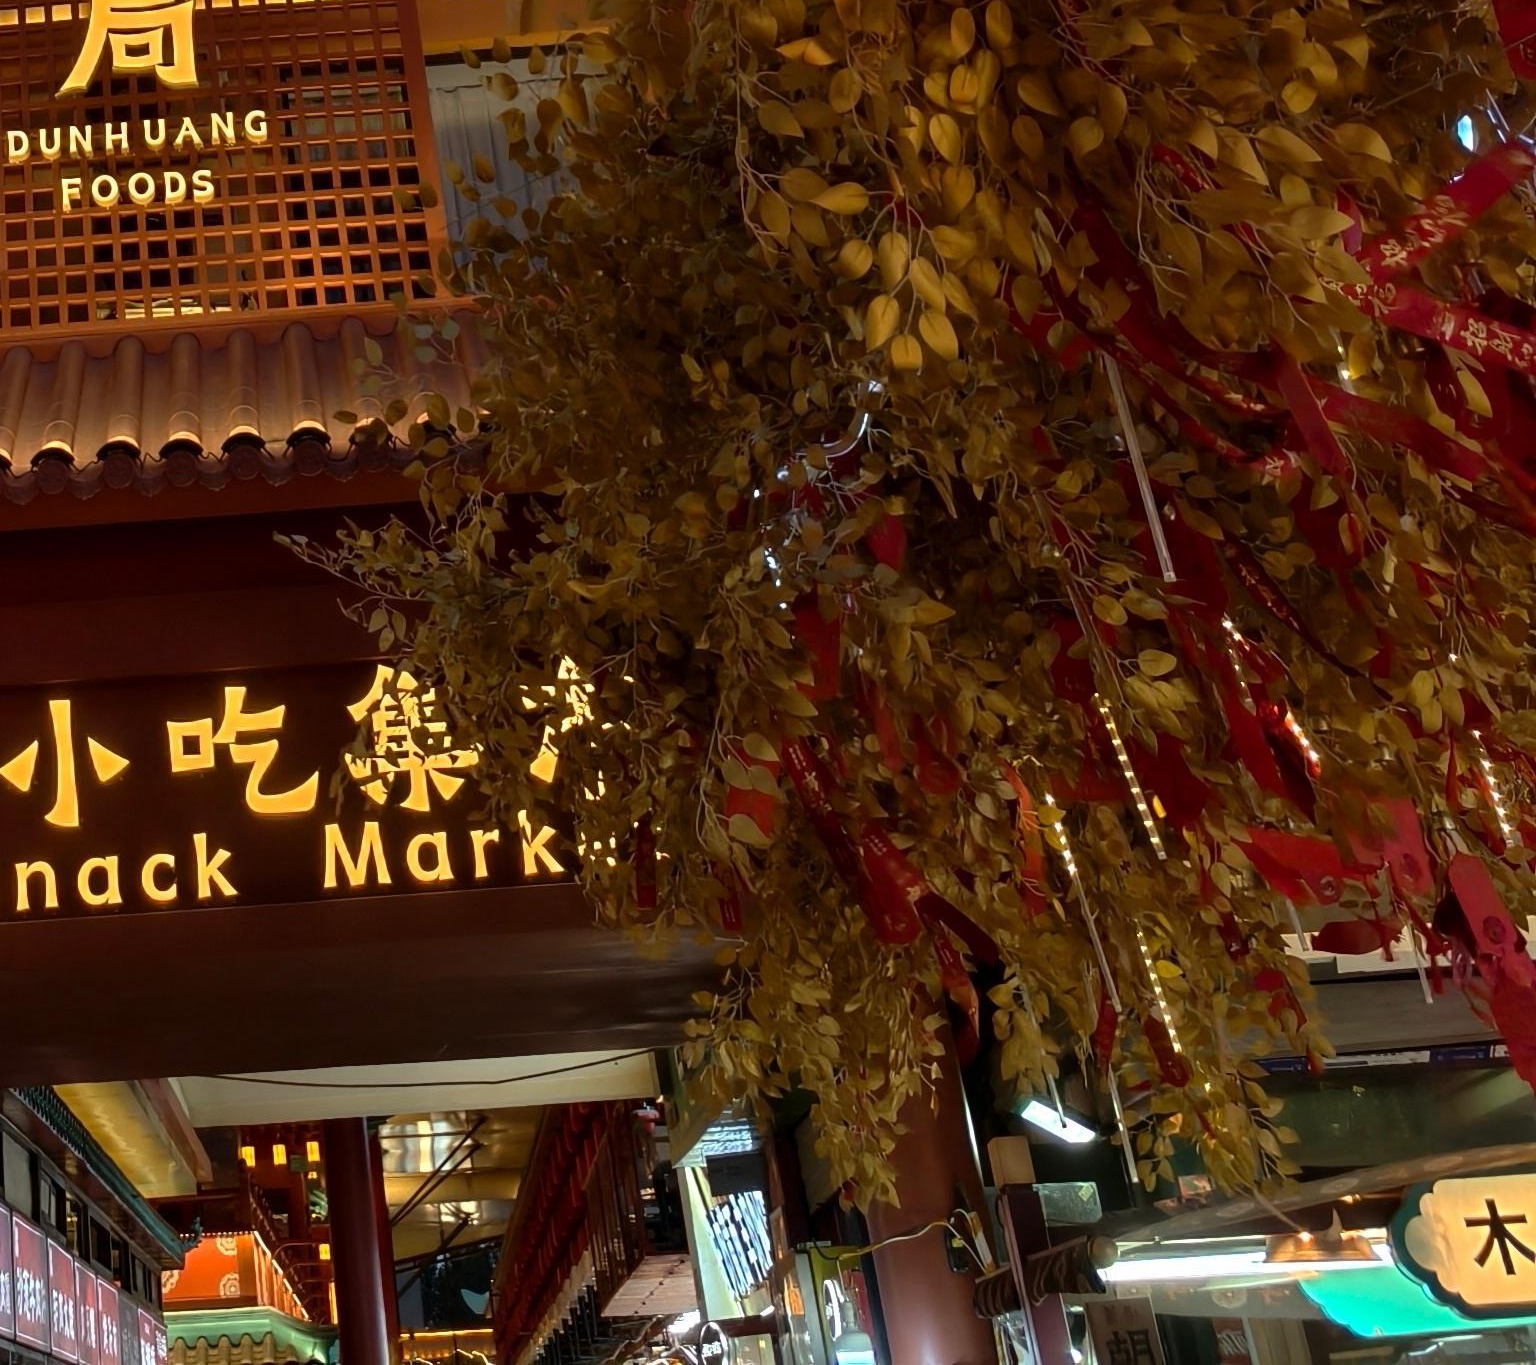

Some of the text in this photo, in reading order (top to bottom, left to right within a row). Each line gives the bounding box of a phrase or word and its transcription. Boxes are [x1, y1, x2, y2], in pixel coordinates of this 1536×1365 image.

[7, 110, 268, 164] DUNHUANG
[61, 169, 215, 212] FOODS
[323, 807, 667, 889] Mark
